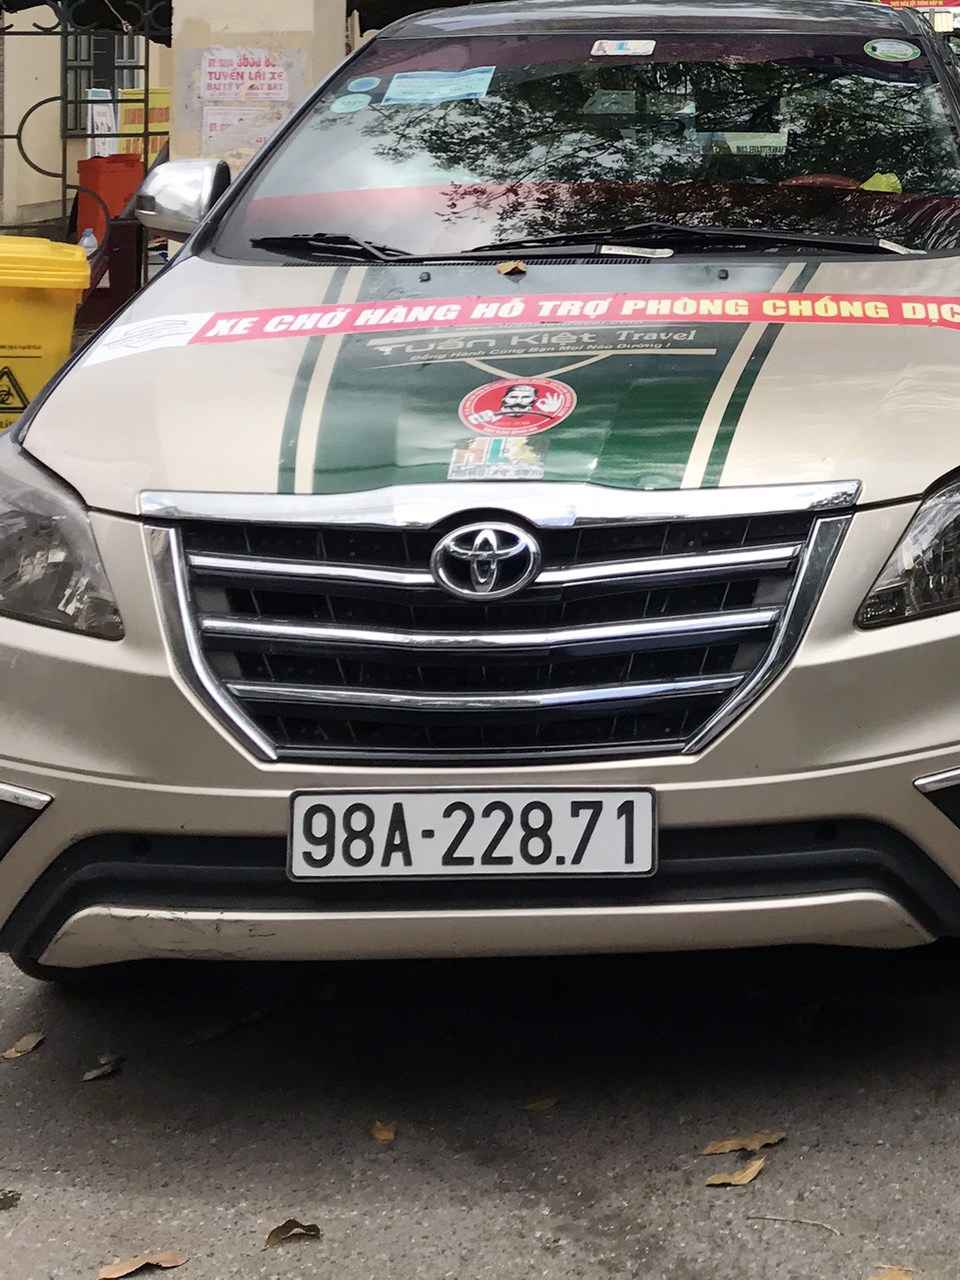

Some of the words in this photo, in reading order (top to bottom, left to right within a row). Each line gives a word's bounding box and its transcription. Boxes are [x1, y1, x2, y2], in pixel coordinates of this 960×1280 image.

[204, 316, 259, 338] XE
[262, 306, 352, 333] CHỞ
[354, 303, 459, 326] HÀNG
[471, 297, 534, 320] HỖ
[536, 297, 613, 319] TRỢ
[621, 295, 749, 316] PHÒNG
[762, 294, 891, 318] CHỐNG
[510, 331, 597, 352] Kiệt
[616, 329, 697, 342] Travel
[302, 800, 635, 868] 98A-228.71
